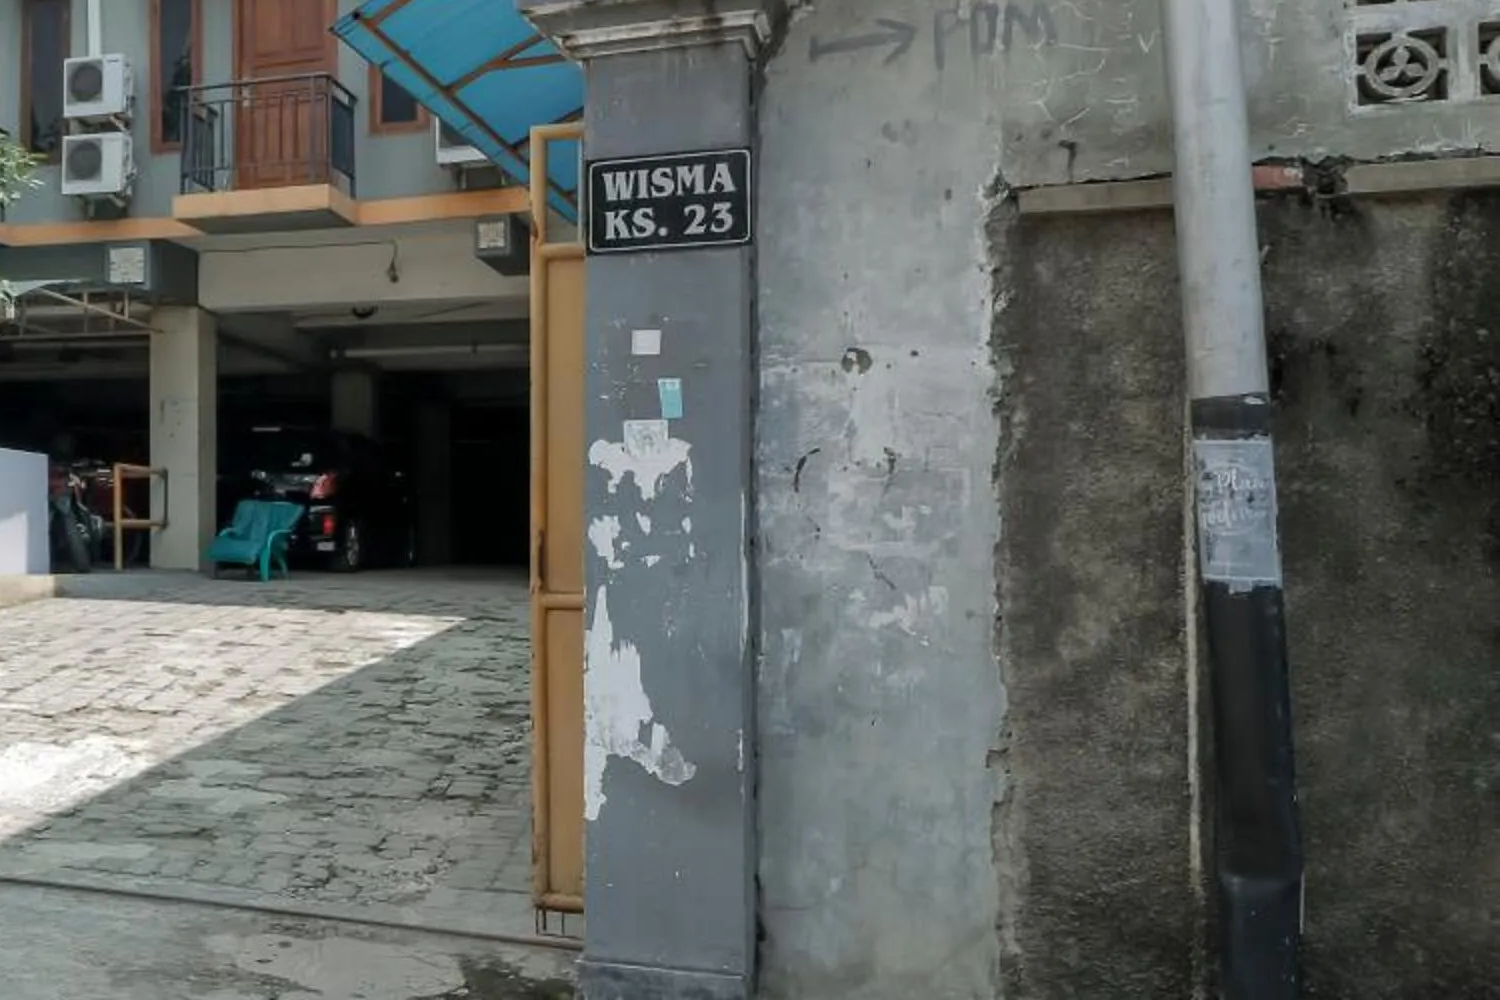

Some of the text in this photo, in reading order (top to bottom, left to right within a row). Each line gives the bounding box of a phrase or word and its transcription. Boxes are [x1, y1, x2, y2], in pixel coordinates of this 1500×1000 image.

[602, 162, 737, 201] WISMA
[604, 202, 734, 240] KS. 23
